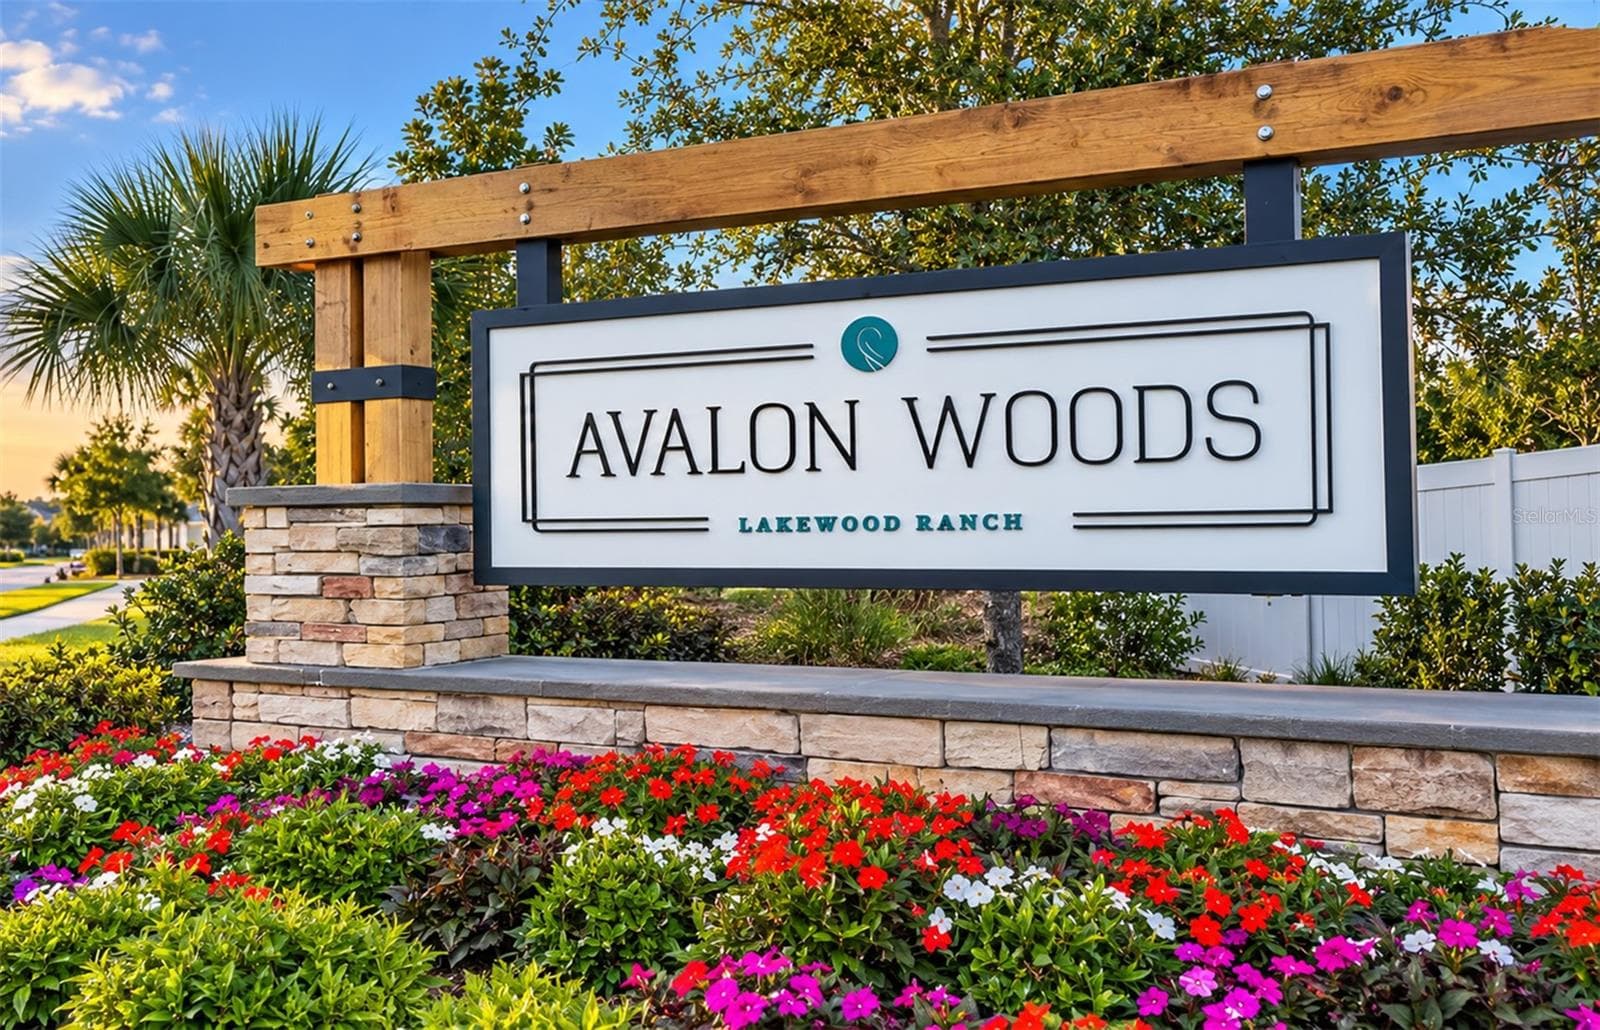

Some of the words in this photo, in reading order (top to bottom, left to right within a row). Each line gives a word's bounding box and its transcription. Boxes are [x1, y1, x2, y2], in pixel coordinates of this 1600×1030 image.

[566, 399, 860, 479] AVALON
[901, 379, 1262, 470] WOODS
[738, 515, 902, 534] LAKEWOOD
[915, 513, 1024, 533] RANCH
